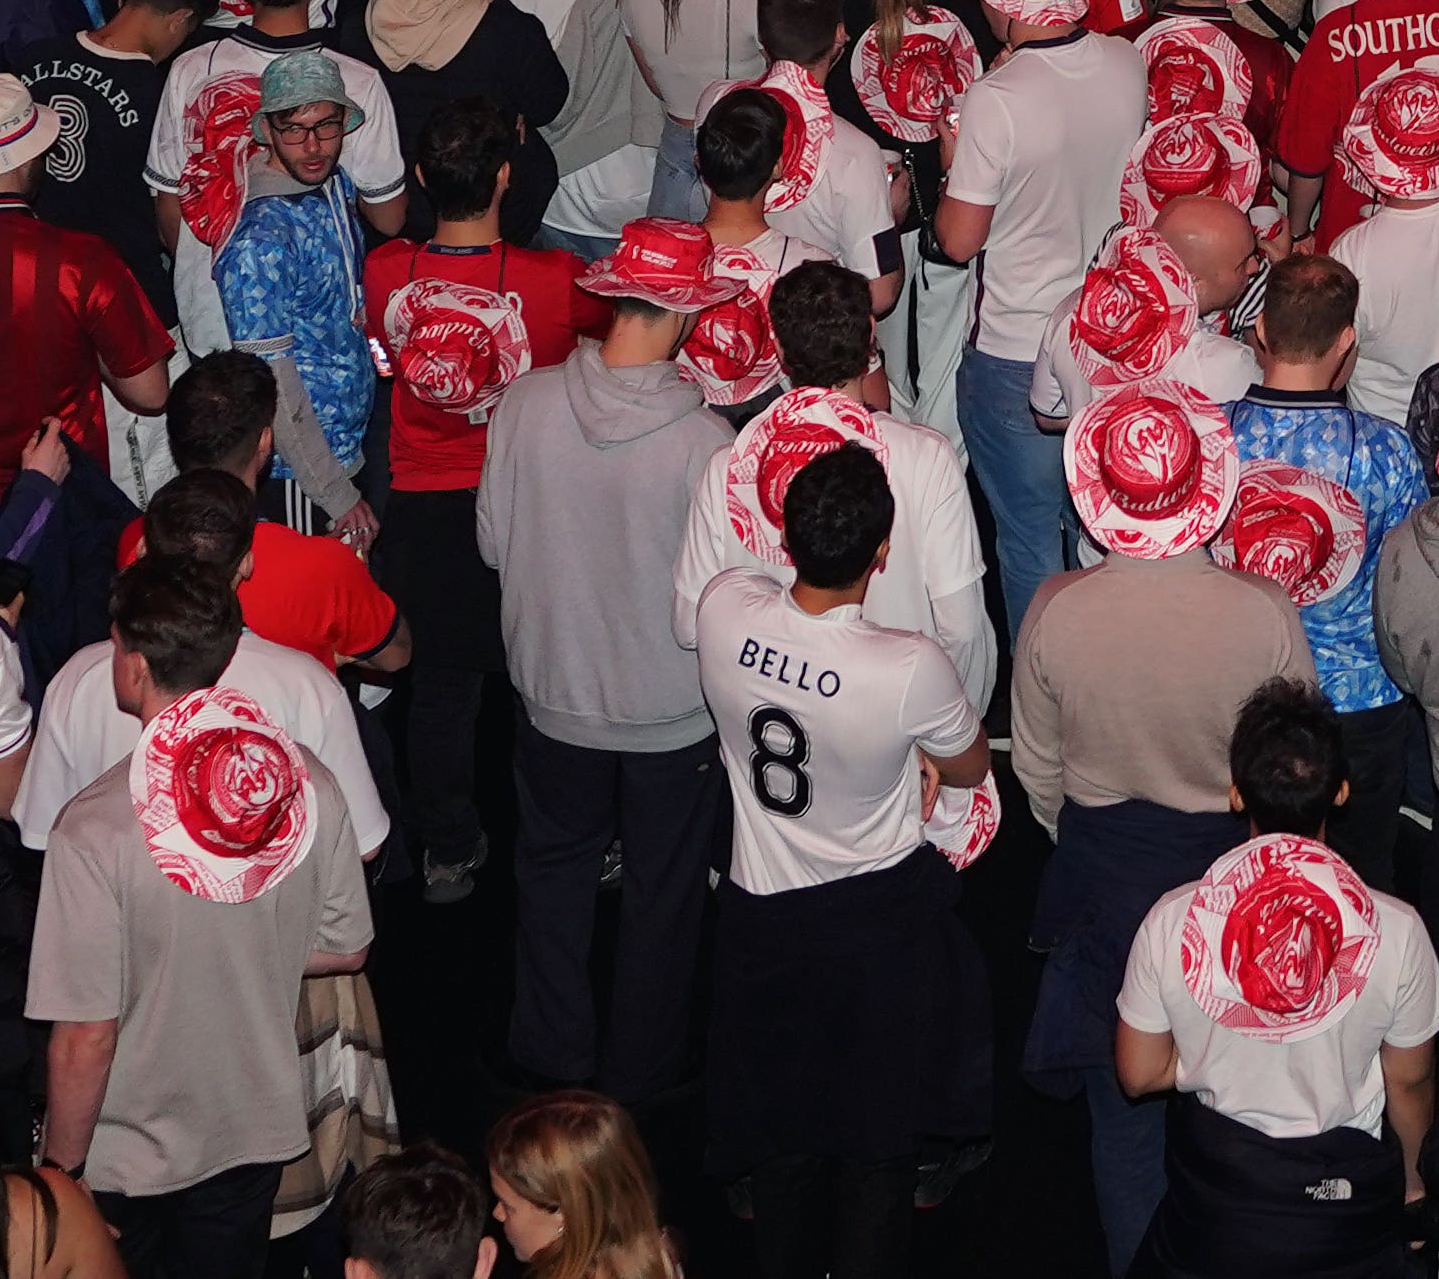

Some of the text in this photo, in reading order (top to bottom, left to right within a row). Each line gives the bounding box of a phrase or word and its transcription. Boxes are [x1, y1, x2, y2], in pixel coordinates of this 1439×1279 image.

[20, 60, 139, 130] ALLSTARS
[46, 93, 89, 183] 3
[738, 637, 841, 699] BELLO
[748, 703, 811, 818] 8
